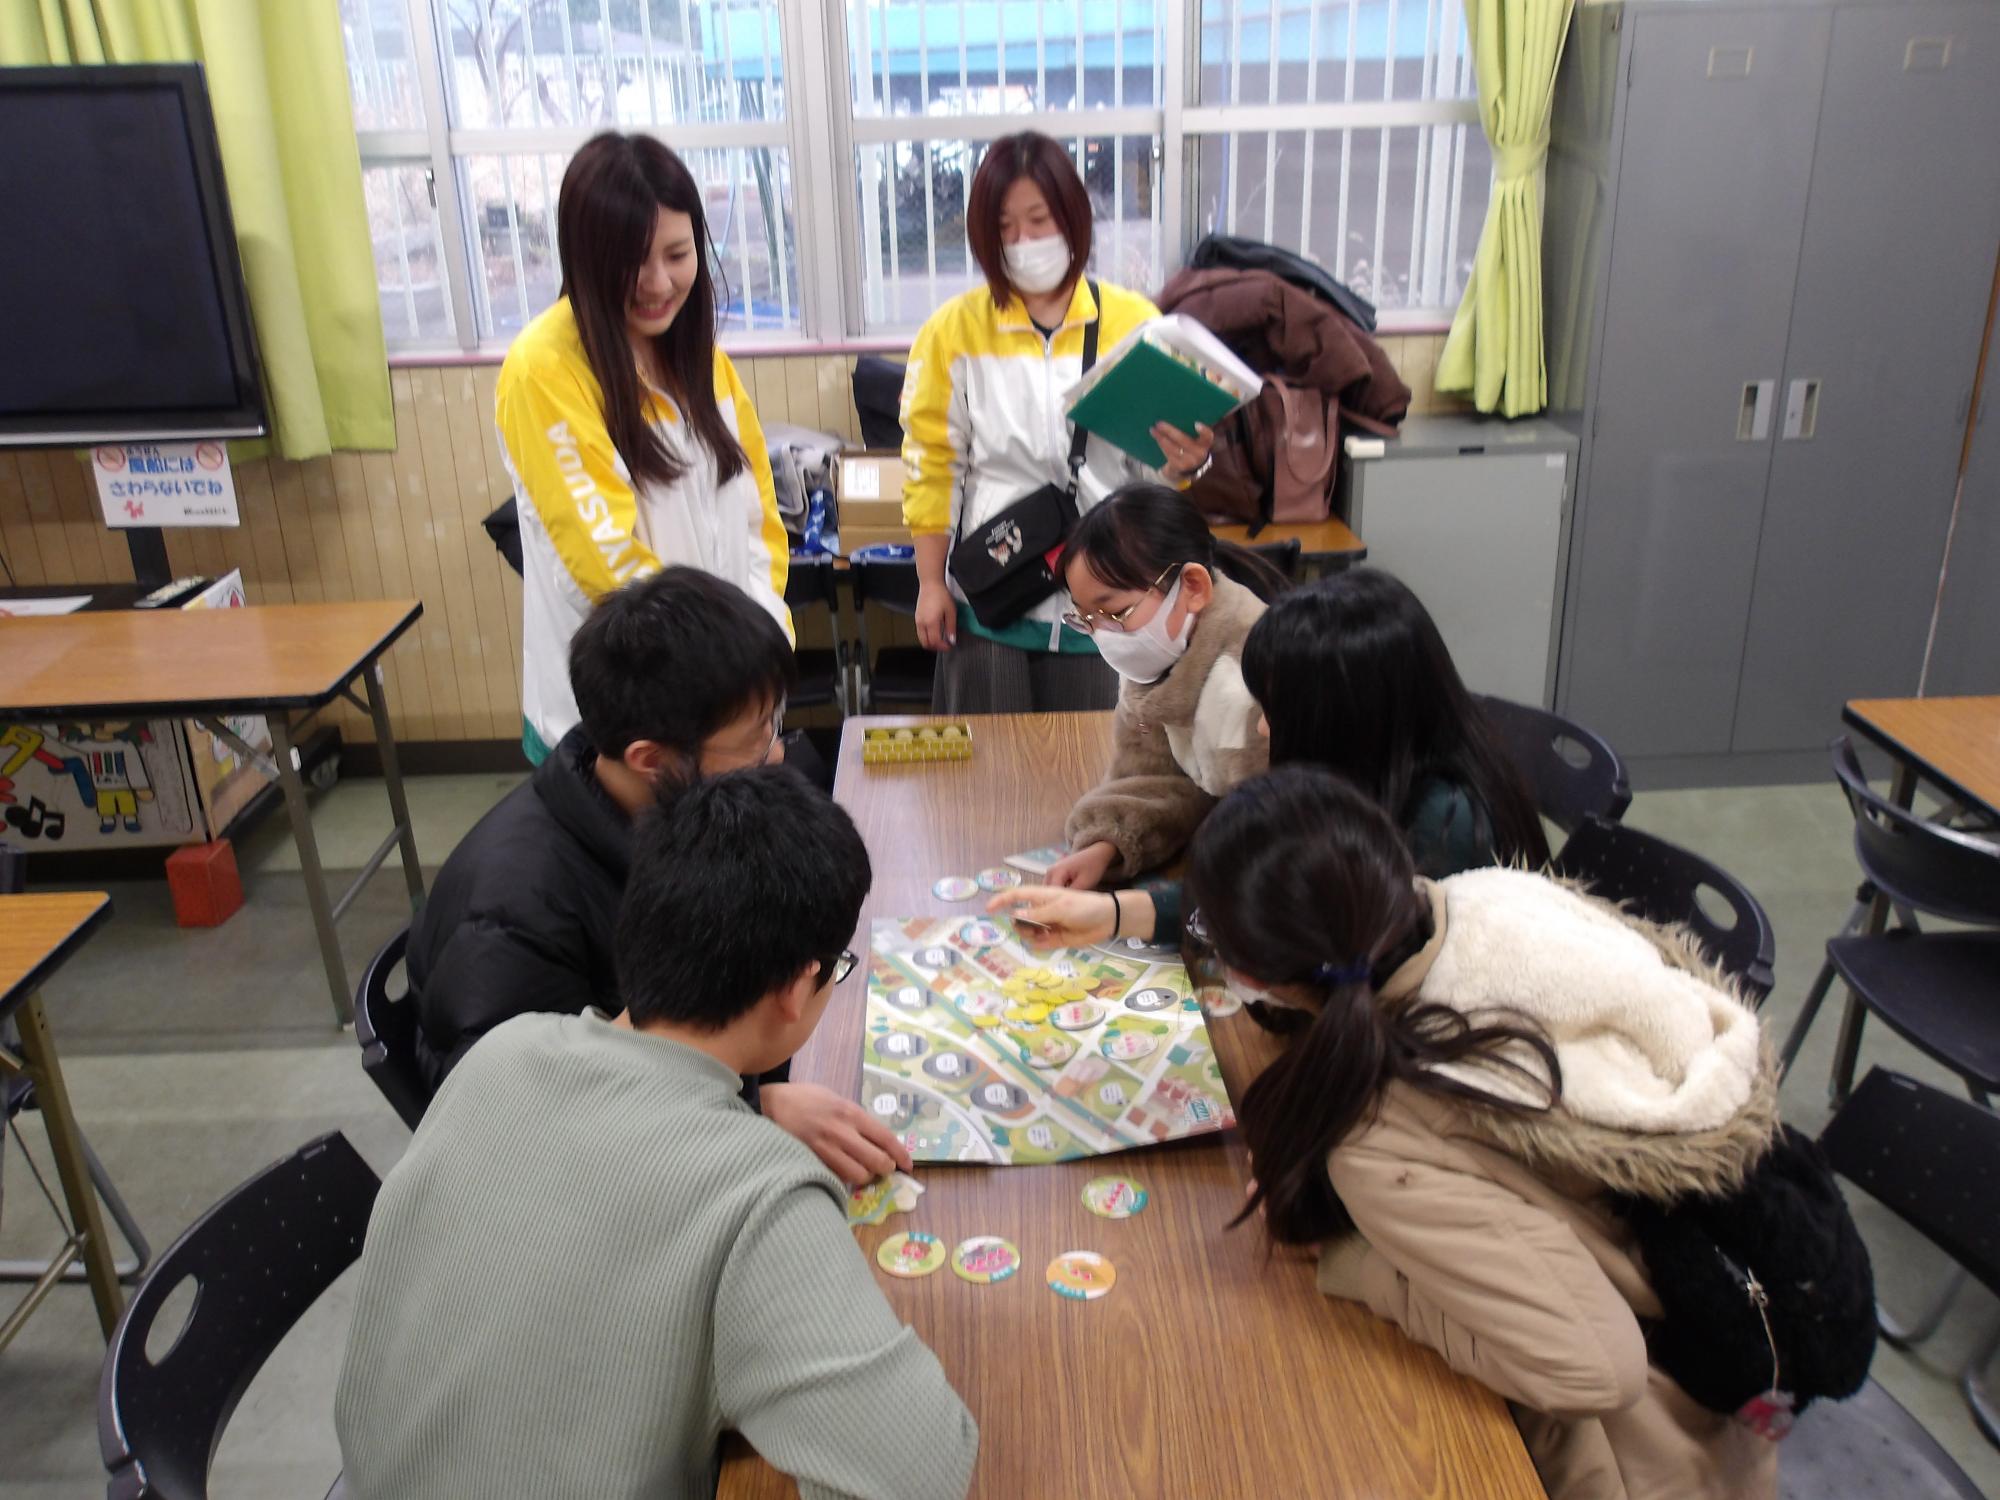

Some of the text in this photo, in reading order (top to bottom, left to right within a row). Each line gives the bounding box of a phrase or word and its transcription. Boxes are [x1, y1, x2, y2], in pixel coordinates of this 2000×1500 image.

[110, 479, 224, 498] さわらないでね
[547, 420, 632, 568] YASUDA
